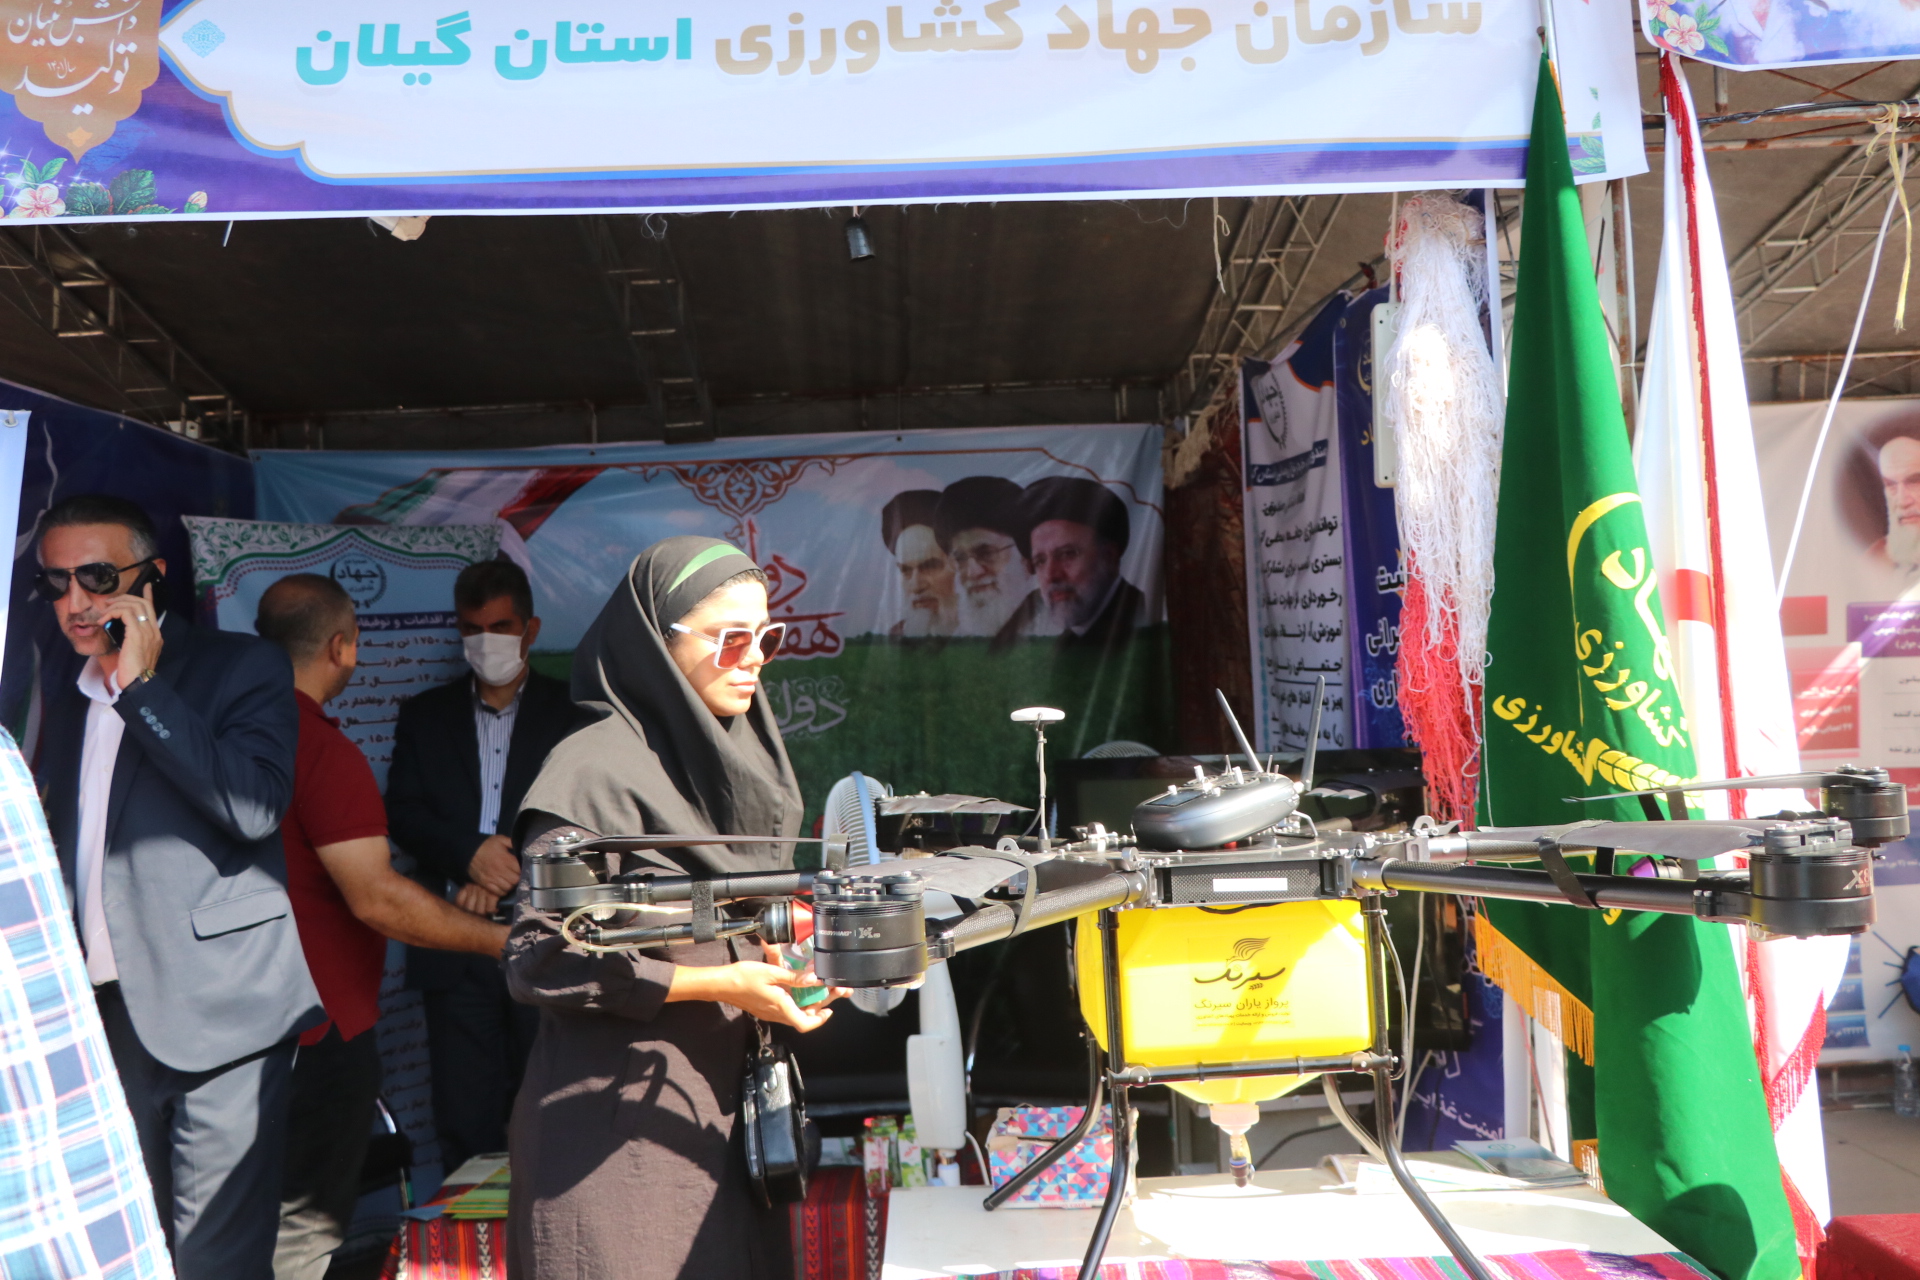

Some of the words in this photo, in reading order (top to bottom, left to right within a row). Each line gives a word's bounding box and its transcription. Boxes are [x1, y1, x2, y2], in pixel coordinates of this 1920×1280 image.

[296, 11, 471, 86] گیلان
[495, 18, 692, 81] استان
[715, 0, 1023, 76] کشاورزی
[1047, 0, 1212, 73] جهاد
[1236, 0, 1482, 64] سازمان
[14, 39, 138, 115] تولید
[394, 618, 401, 628] و
[404, 614, 443, 626] اقدامات
[1236, 998, 1262, 1010] یاران
[1265, 997, 1289, 1010] پرواز
